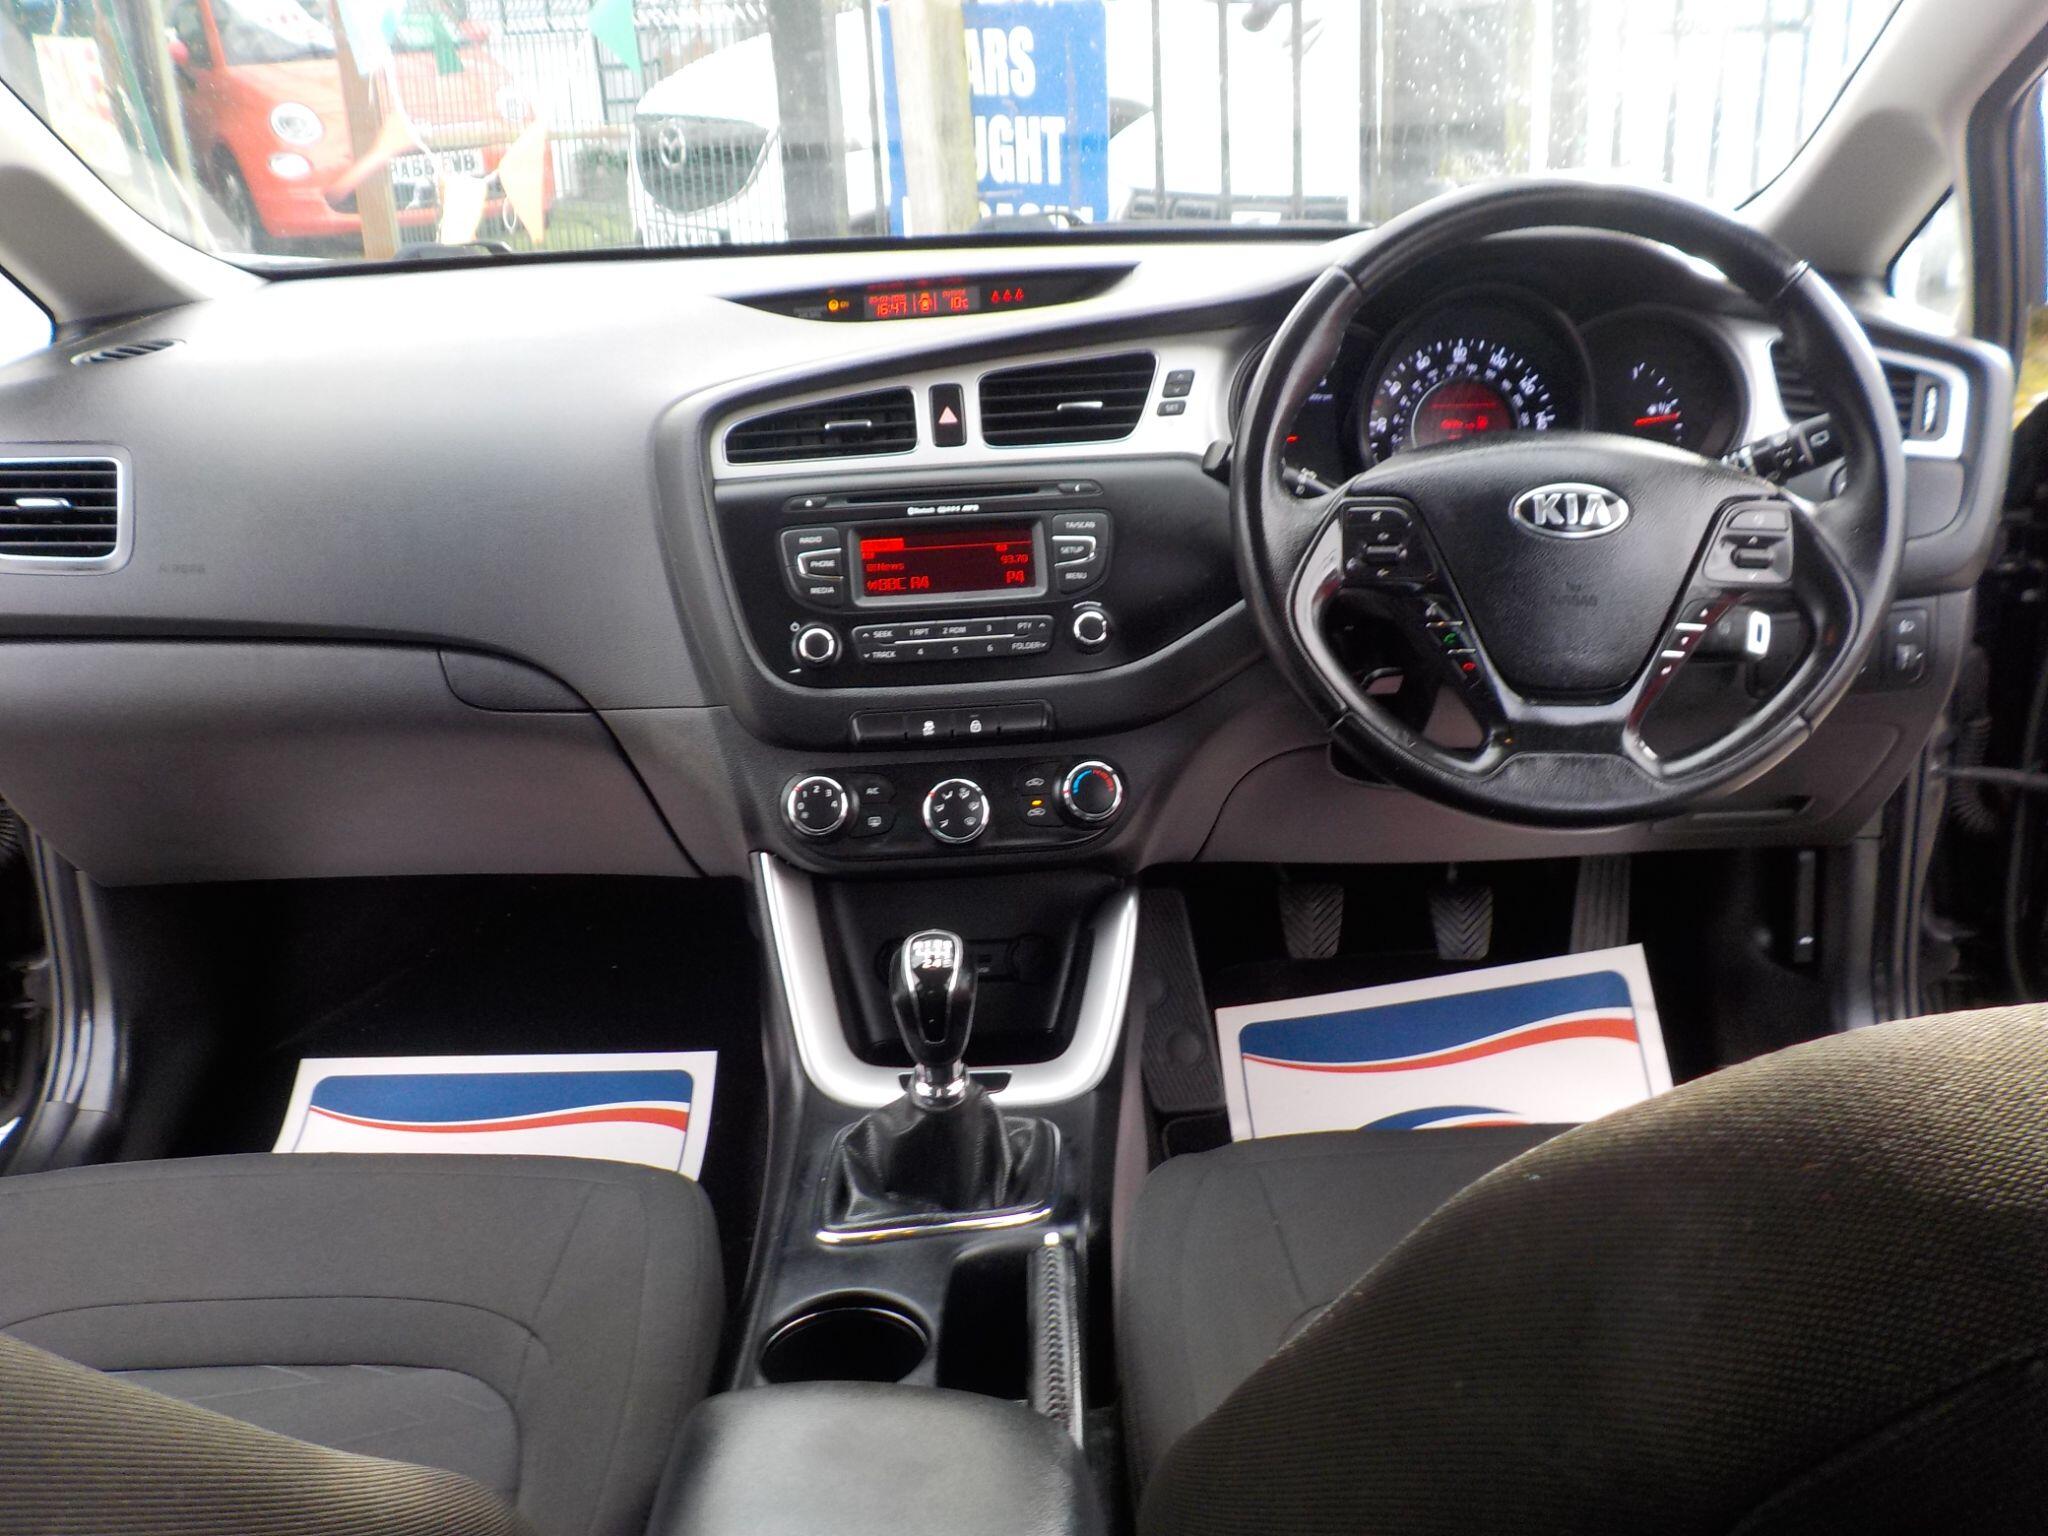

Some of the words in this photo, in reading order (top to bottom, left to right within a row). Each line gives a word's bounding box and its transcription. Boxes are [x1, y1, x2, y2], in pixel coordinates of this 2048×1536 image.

[964, 26, 1036, 97] ARS
[974, 114, 1066, 186] UGHT
[1532, 492, 1613, 526] KIA
[798, 535, 823, 544] RADIO
[1060, 545, 1085, 555] SETUP
[810, 559, 835, 568] PHONE
[1065, 571, 1088, 580] MENU
[810, 586, 835, 595] MEDIA
[872, 630, 893, 639] SEEK
[1011, 641, 1041, 651] FOLDER
[872, 650, 897, 659] TRACK
[813, 784, 821, 794] 2
[825, 788, 833, 798] 3
